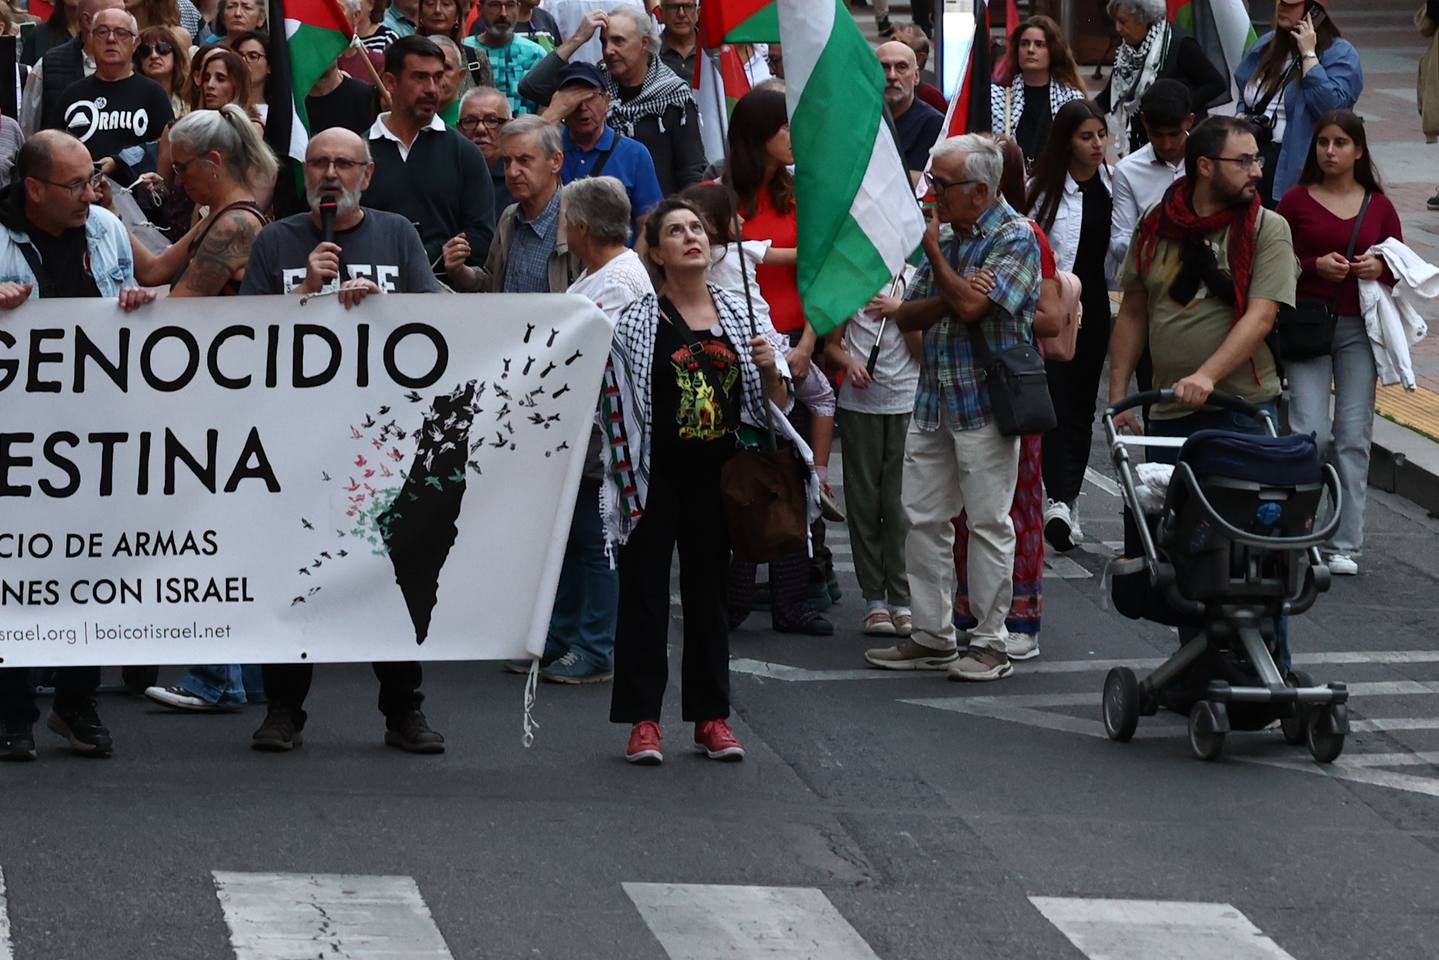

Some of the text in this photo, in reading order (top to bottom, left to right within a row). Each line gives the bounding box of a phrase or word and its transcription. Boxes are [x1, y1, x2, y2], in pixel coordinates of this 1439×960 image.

[66, 533, 103, 558] DE
[112, 530, 218, 557] ARMAS
[70, 577, 142, 604] CON
[157, 577, 254, 603] ISRAEL
[95, 621, 232, 640] boicotisrael.net
